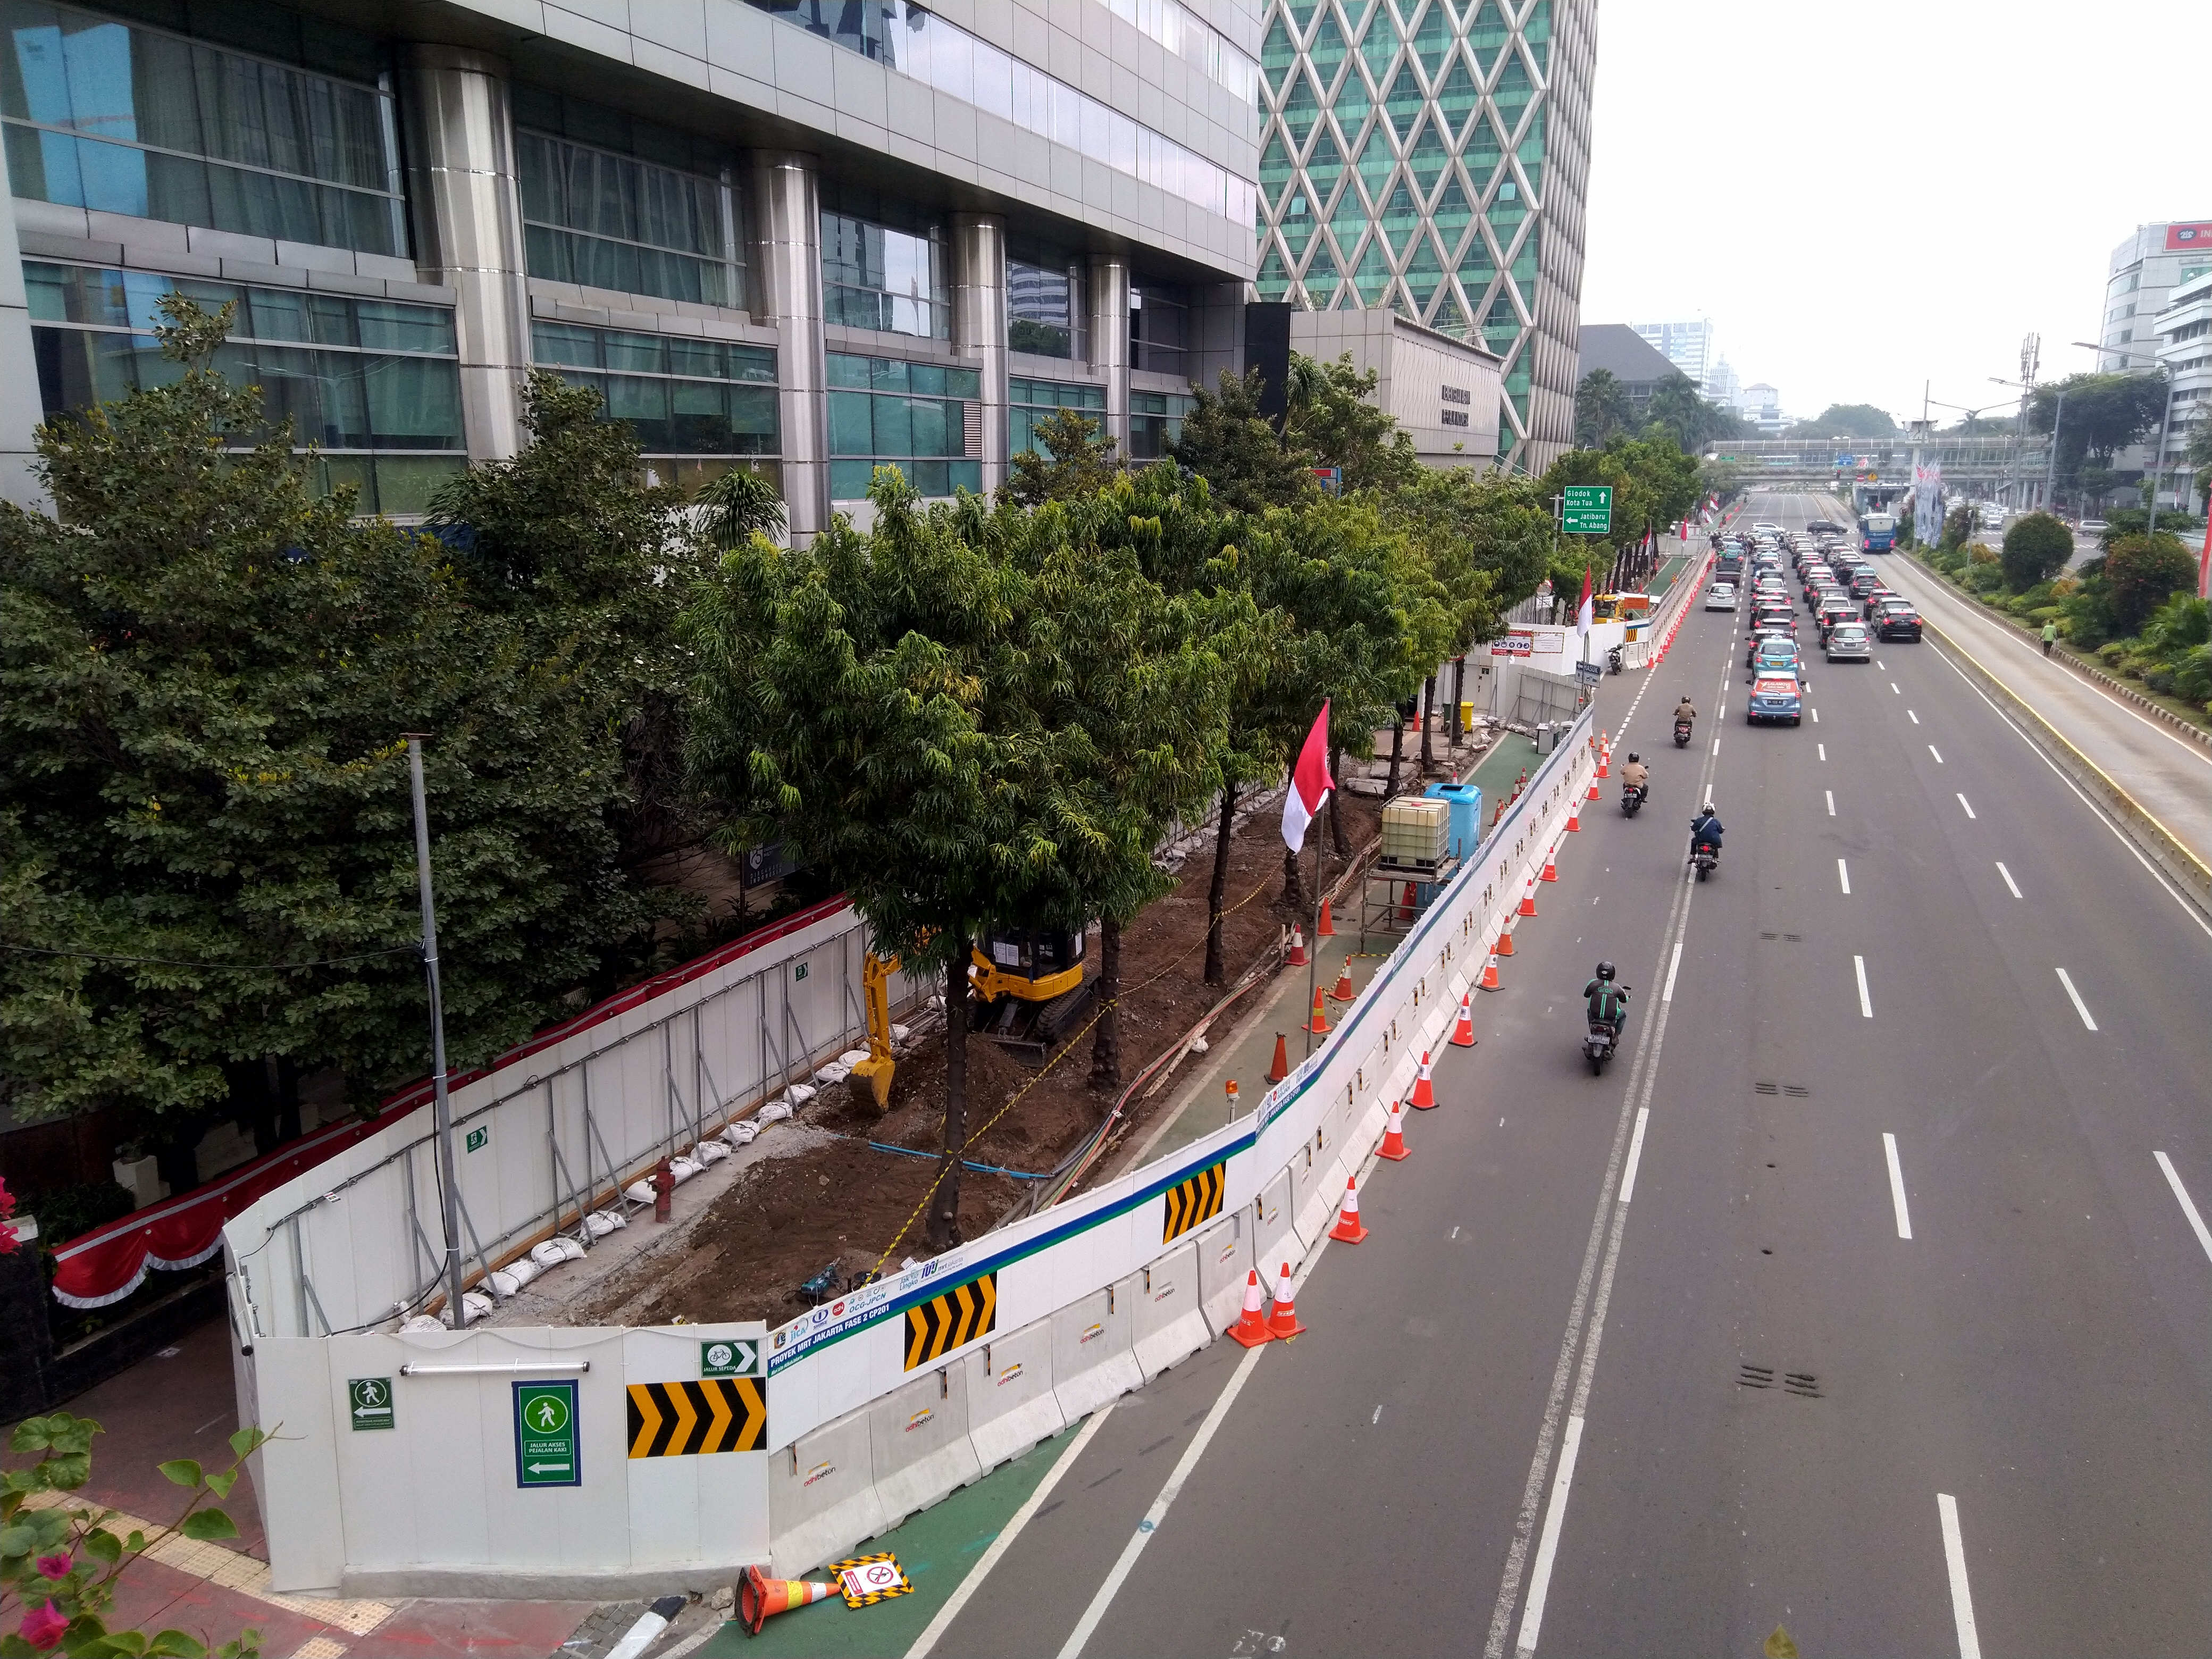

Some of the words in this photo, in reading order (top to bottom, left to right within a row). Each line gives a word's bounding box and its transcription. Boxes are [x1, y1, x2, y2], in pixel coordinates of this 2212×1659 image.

[900, 1279, 918, 1291] Lingko
[850, 1293, 886, 1313] OCG-JPCN
[770, 1347, 797, 1368] PROYEK
[798, 1339, 811, 1353] MRT
[813, 1324, 843, 1344] JAKARTA
[845, 1316, 861, 1330] FASE
[869, 1304, 890, 1319] CP201
[1080, 1329, 1104, 1344] adhibeton
[997, 1370, 1024, 1387] adhibeton
[906, 1414, 934, 1432] adhibeton
[804, 1467, 836, 1487] adhibeton
